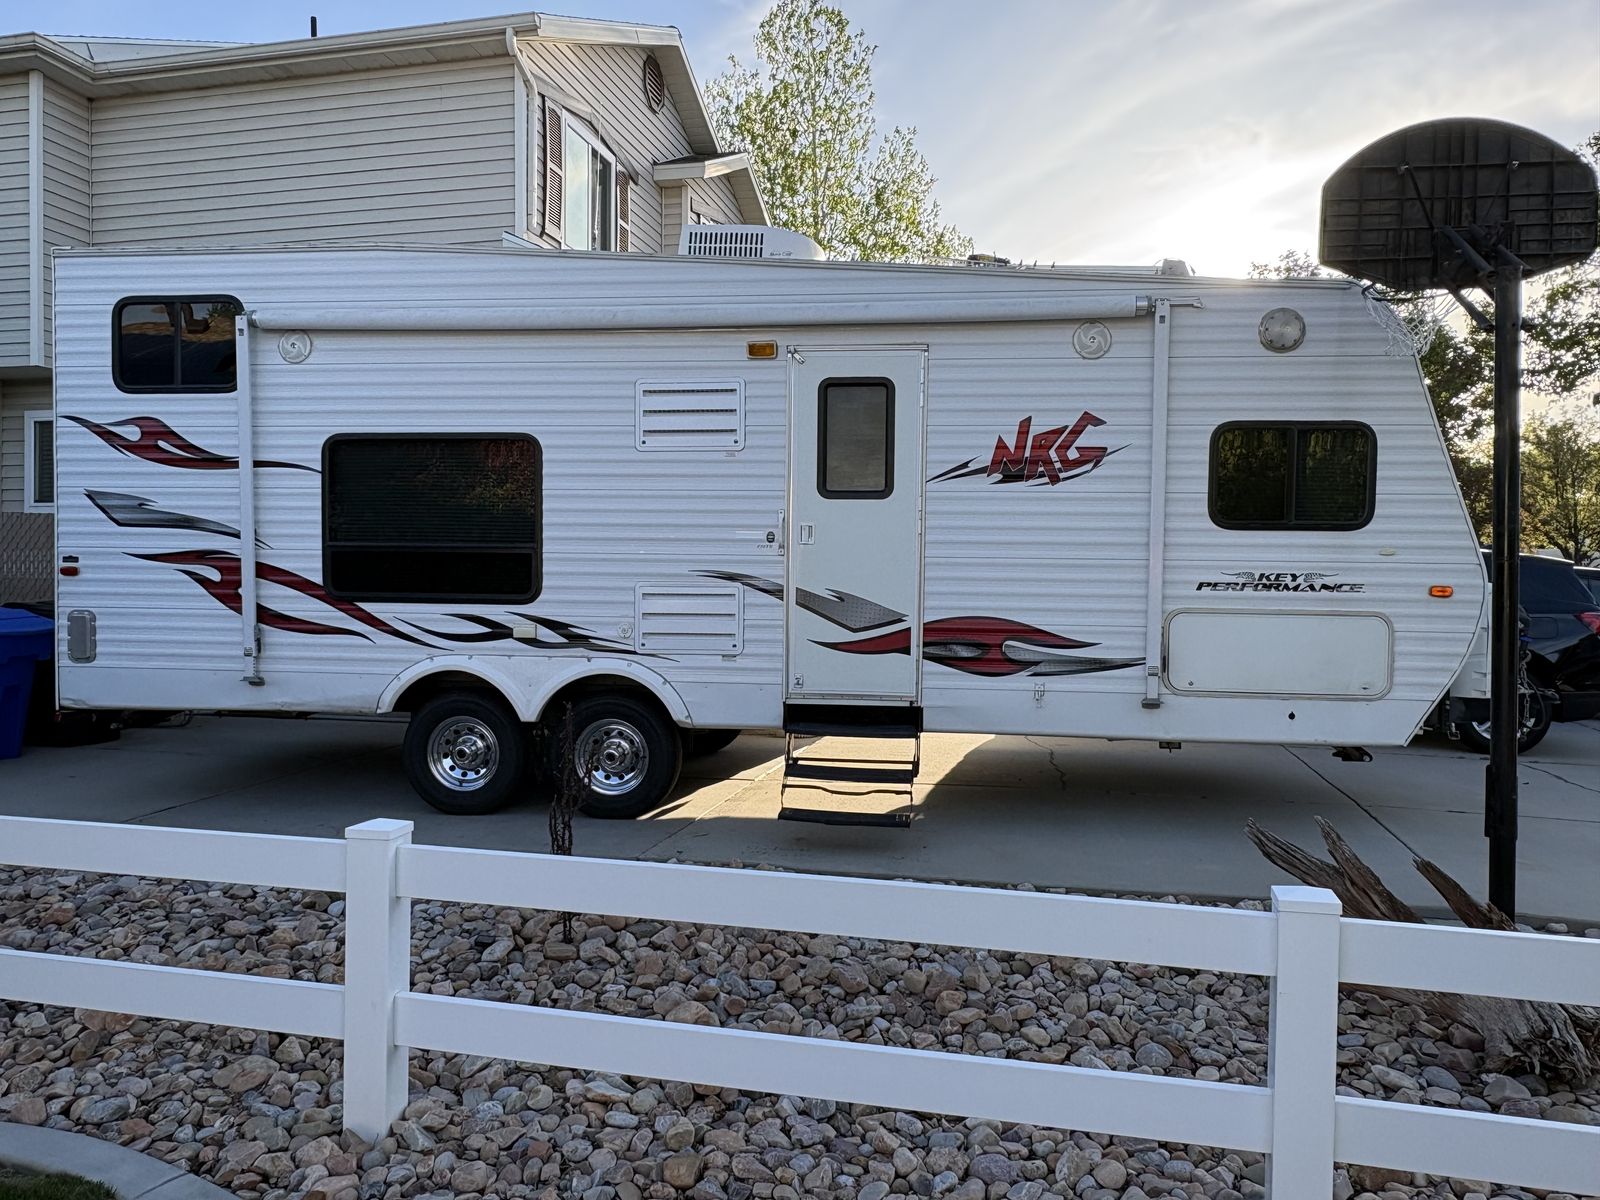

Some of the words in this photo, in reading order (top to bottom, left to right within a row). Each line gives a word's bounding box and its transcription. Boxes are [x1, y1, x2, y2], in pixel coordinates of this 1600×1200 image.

[986, 411, 1108, 486] NRG
[1257, 572, 1304, 582] KEY
[1195, 581, 1365, 593] PERFORMANCE
